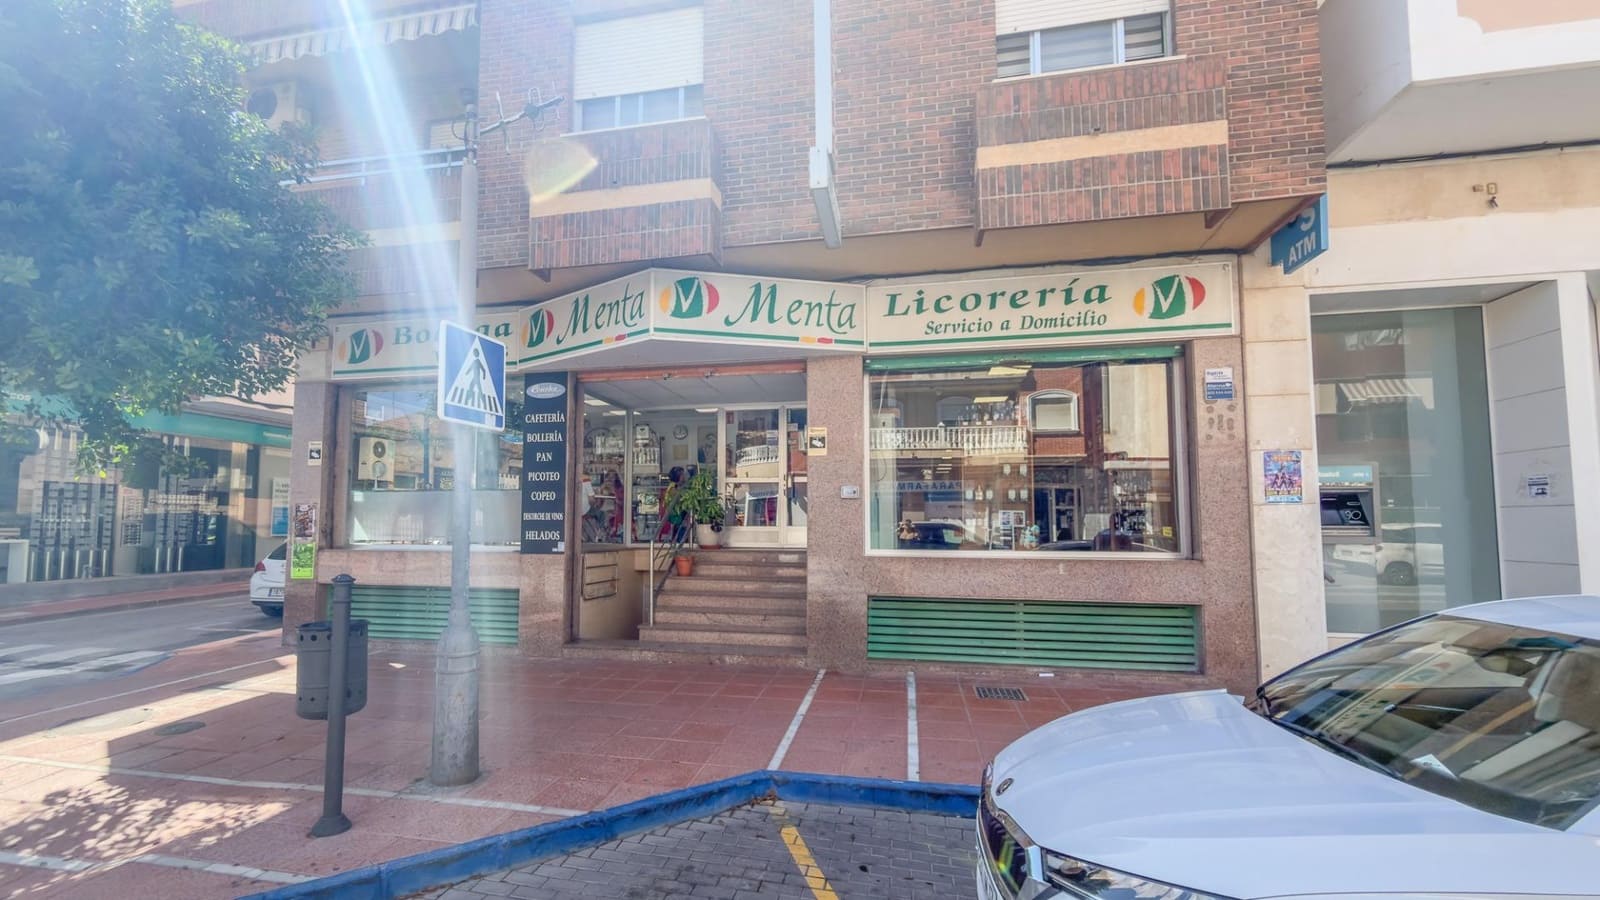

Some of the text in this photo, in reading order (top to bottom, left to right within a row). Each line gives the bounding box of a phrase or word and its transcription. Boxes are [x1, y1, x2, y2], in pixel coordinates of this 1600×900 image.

[1289, 232, 1316, 266] ATM
[883, 277, 1113, 317] Licorería
[555, 282, 646, 345] Menta
[724, 281, 857, 335] Menta
[924, 308, 1108, 336] Servicio a Domicilio
[525, 410, 565, 424] CAFETERÍA
[527, 430, 563, 443] BOLLERÍA
[536, 452, 552, 462] PAN
[528, 472, 560, 482] PICOTEO
[531, 491, 556, 501] COPEO
[525, 530, 561, 541] HELADOS
